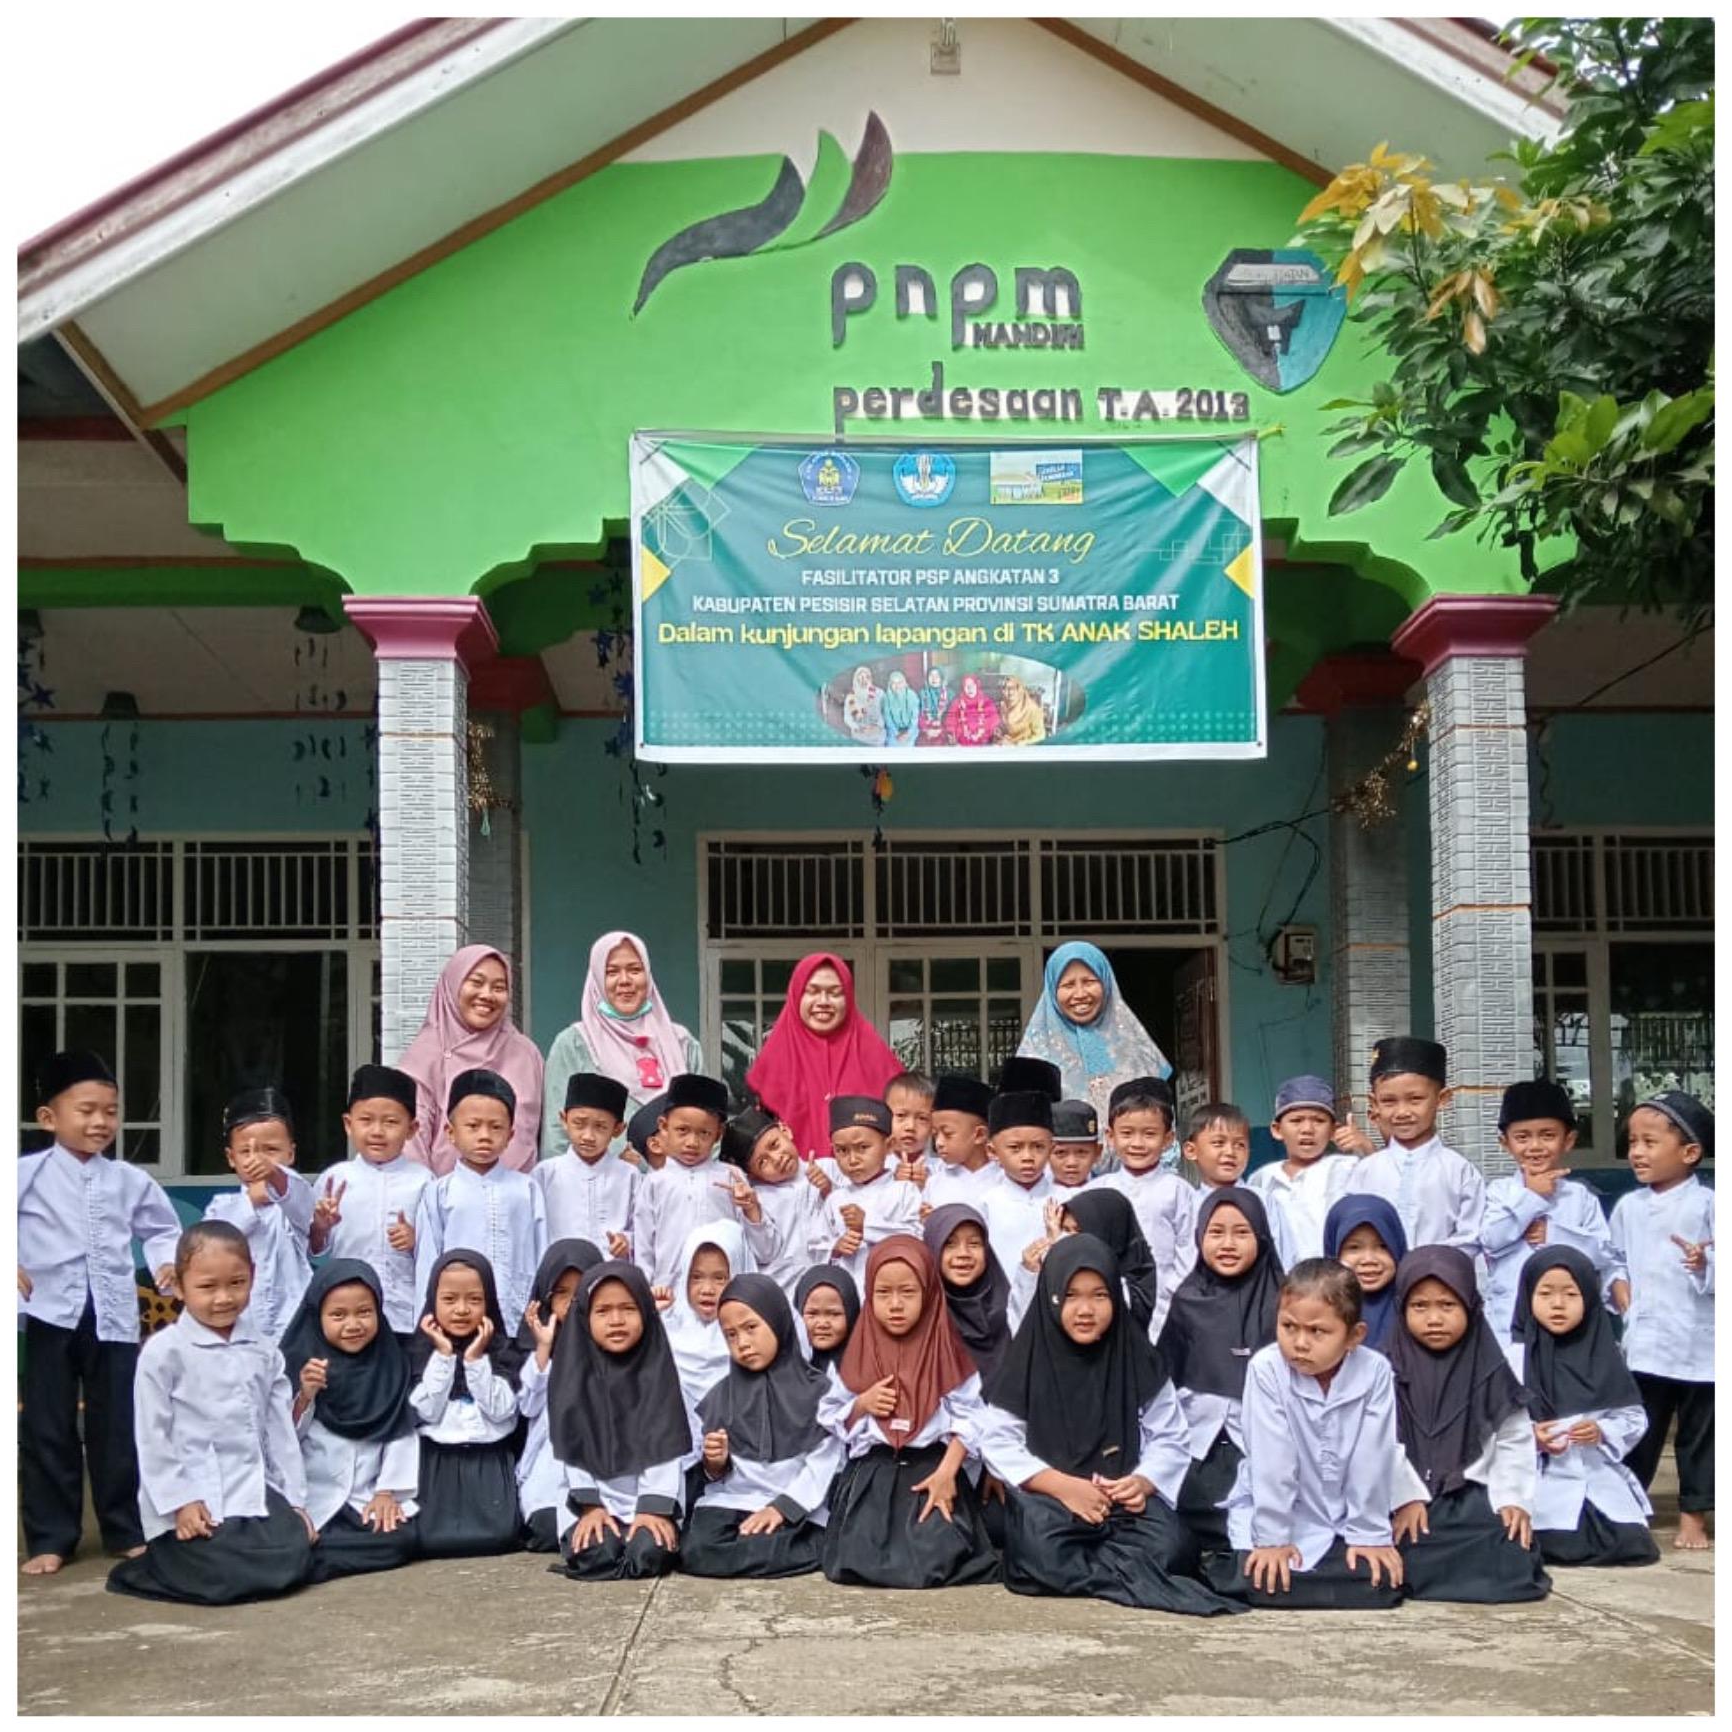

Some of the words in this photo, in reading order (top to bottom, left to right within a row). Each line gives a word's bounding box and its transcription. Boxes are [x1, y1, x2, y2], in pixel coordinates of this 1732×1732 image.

[831, 261, 1083, 350] pnpm
[833, 360, 1083, 442] perdesaan
[1175, 387, 1250, 422] 2013
[768, 518, 935, 560] Selamat
[942, 516, 1096, 565] Datang
[801, 569, 911, 586] FASILITATOR
[915, 569, 949, 585] PSP
[953, 568, 1045, 584] ANGKATAN
[1048, 568, 1060, 584] 3
[692, 594, 796, 613] KABUPATEN
[799, 596, 867, 613] PESISIR
[870, 596, 949, 613] SELATAN
[953, 596, 1033, 613] PROVINSI
[1037, 595, 1120, 612] SUMATRA
[1123, 594, 1180, 611] BARAT
[658, 622, 733, 644] Dalam
[740, 622, 870, 647] kunjungan
[875, 622, 991, 648] lapangan
[993, 621, 1014, 643] di
[1021, 622, 1054, 642] TK
[1060, 621, 1132, 642] ANAK
[1137, 619, 1239, 641] SHALEH
